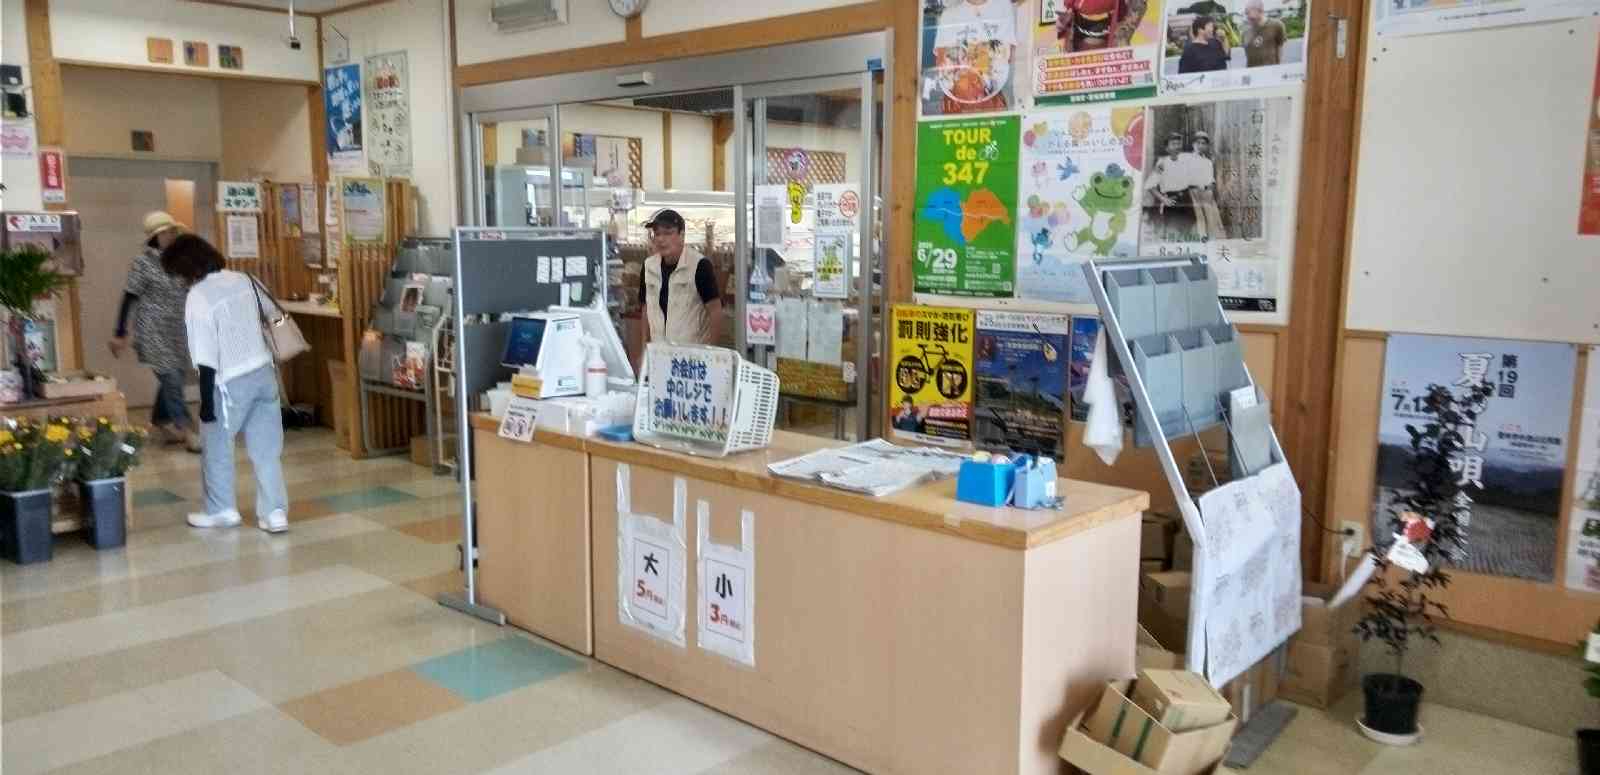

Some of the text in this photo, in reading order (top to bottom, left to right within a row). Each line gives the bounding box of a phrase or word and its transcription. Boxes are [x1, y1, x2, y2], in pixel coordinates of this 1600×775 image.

[943, 128, 992, 145] TOUR
[956, 146, 977, 160] de
[943, 161, 989, 185] 347
[224, 198, 259, 208] スタンプ
[227, 186, 256, 196] 道の駅
[30, 215, 59, 224] AED
[917, 248, 957, 269] 6/29
[898, 319, 969, 343] 罰則強化
[671, 356, 707, 381] お会計は
[1498, 354, 1519, 399] 第19回
[667, 377, 712, 402] 中のレジで
[643, 552, 659, 576] 大
[715, 572, 733, 599] 小
